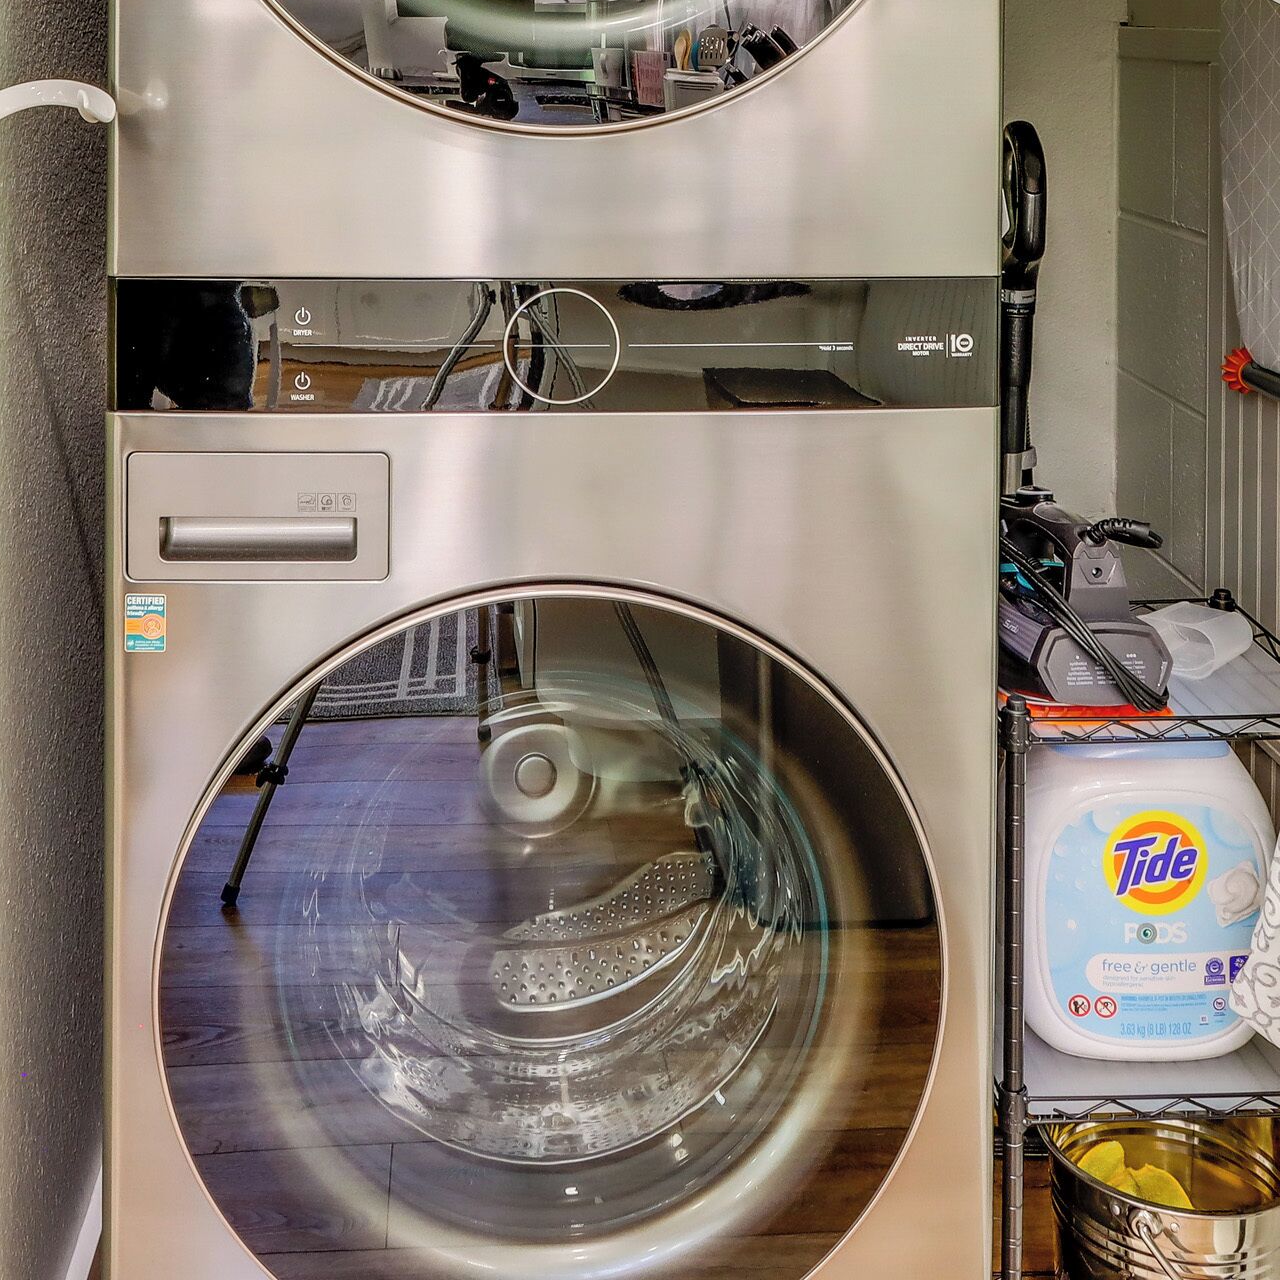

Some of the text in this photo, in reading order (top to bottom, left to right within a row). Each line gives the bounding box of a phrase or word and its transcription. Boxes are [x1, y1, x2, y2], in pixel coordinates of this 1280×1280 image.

[897, 342, 945, 351] DIRECT DRIVE
[127, 596, 164, 605] CERTIFIED
[1114, 836, 1198, 896] Tide
[1102, 958, 1132, 973] free
[1134, 961, 1148, 974] &
[1150, 959, 1197, 975] gentle
[1120, 1023, 1135, 1036] 3.63
[1136, 1023, 1146, 1038] kg
[1155, 1022, 1167, 1036] LB)
[1169, 1022, 1181, 1035] 128
[1182, 1022, 1192, 1035] OZ
